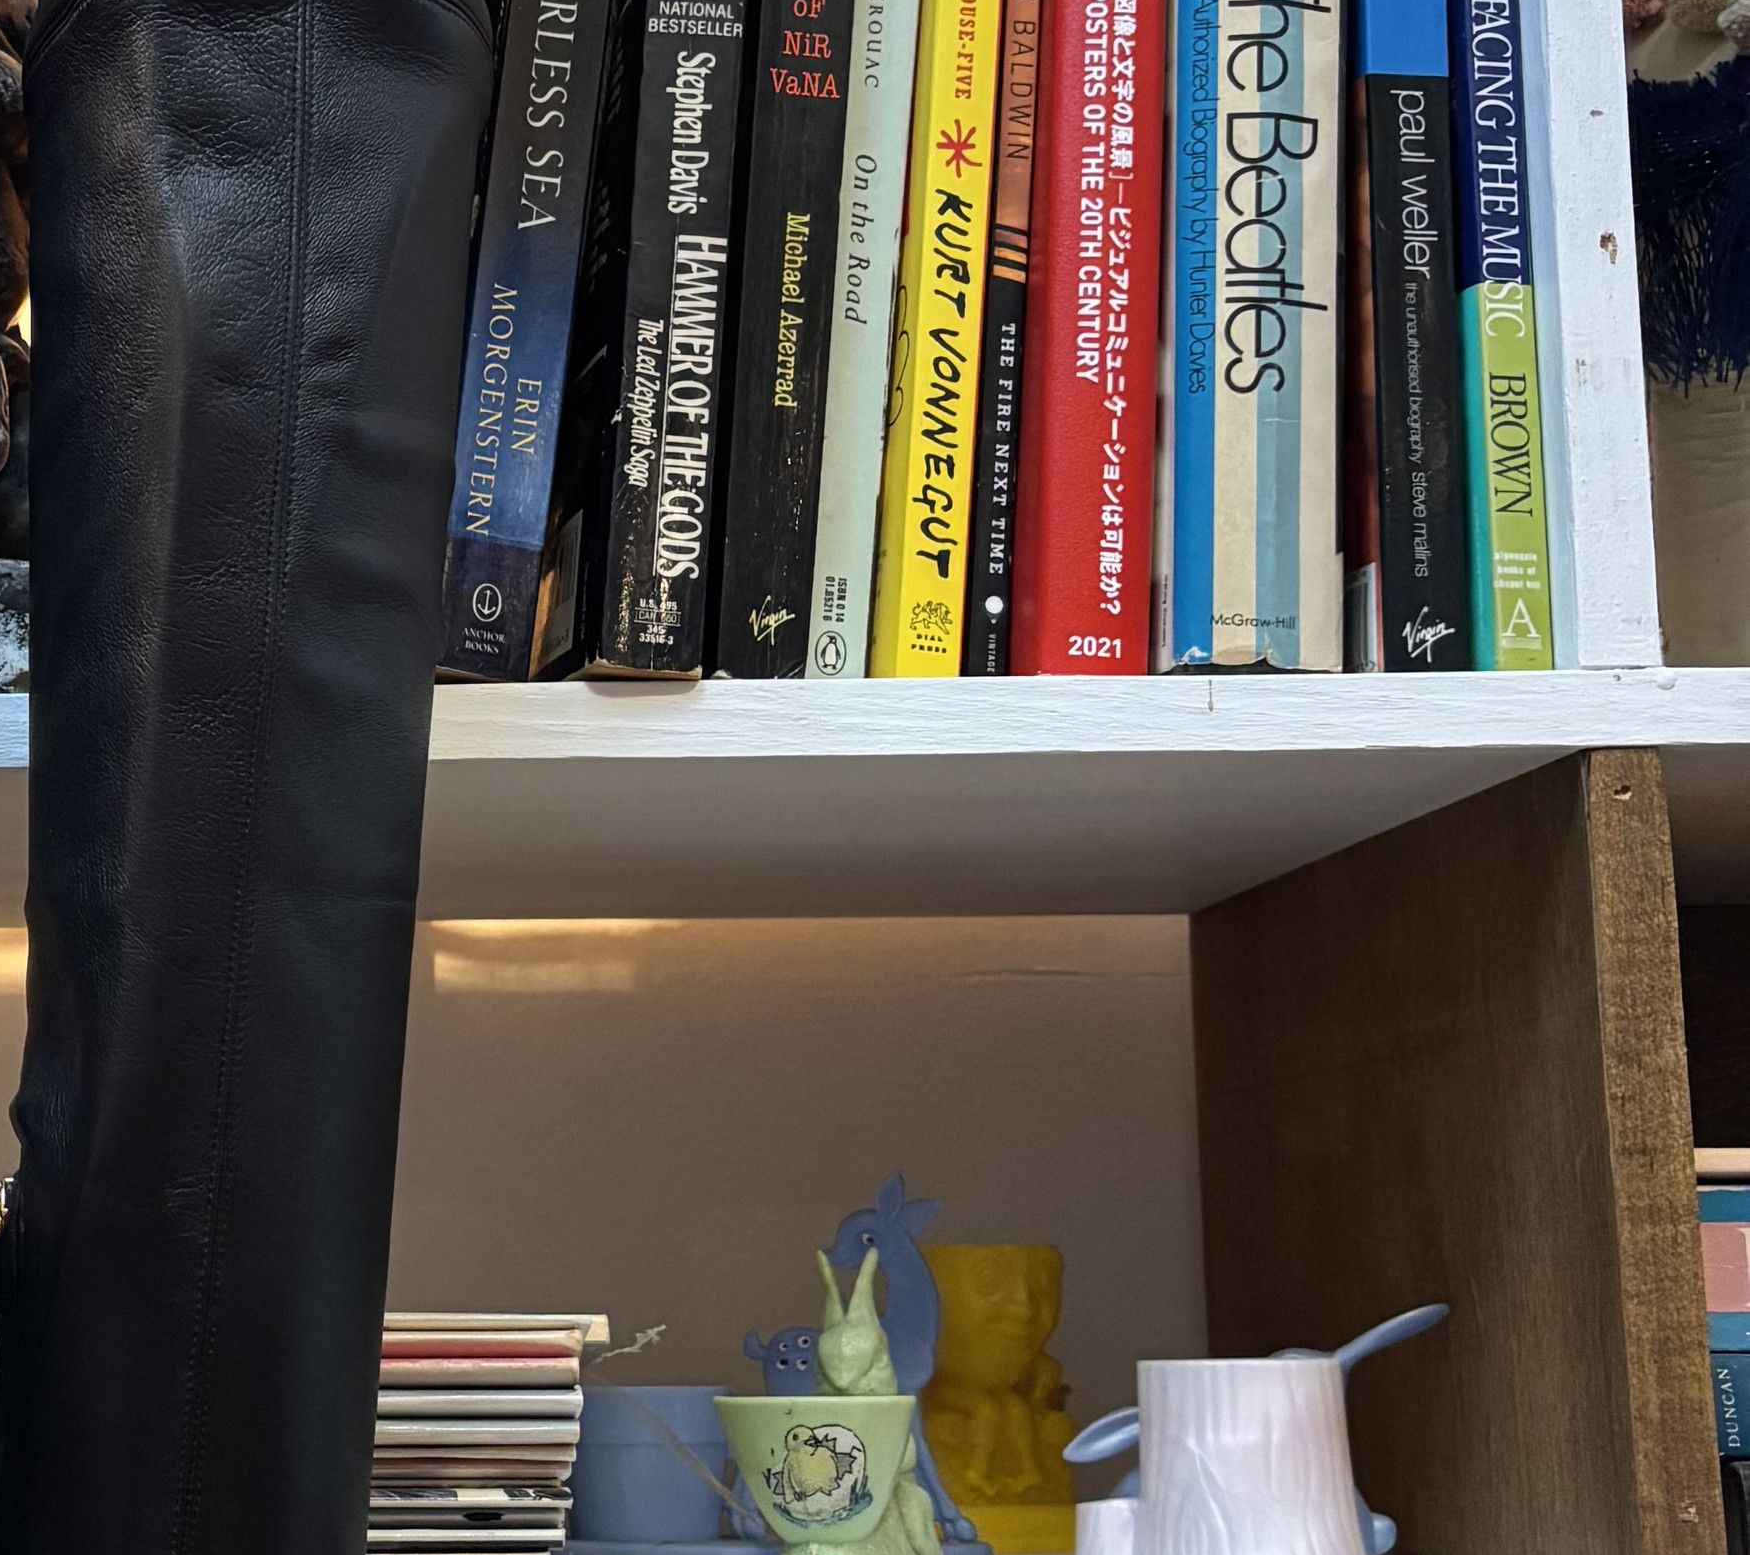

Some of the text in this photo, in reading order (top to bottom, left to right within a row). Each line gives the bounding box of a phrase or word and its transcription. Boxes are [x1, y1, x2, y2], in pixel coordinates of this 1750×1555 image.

[648, 18, 744, 39] BESTSELLER
[659, 0, 735, 20] NATIONAL
[666, 50, 717, 216] Stephen Davis
[1006, 20, 1036, 161] BALDWIN
[1081, 104, 1106, 135] OF
[517, 145, 565, 231] SEA
[1080, 142, 1105, 192] THE
[1184, 106, 1221, 213] Biography
[1390, 89, 1440, 280] paul weller
[1477, 137, 1521, 217] THE
[845, 154, 878, 325] On the Road
[1079, 197, 1104, 259] 20TH
[1182, 216, 1219, 246] by
[1224, 111, 1329, 396] Beatles
[774, 211, 811, 409] Michael Azerrad
[1075, 264, 1102, 384] CENTURY
[1189, 251, 1217, 317] Hunter
[1481, 222, 1526, 338] MUSIC
[912, 188, 974, 579] KURT VONNEGUT
[1188, 320, 1215, 394] Davies
[465, 282, 519, 537] MORGENSTERN
[510, 377, 543, 455] ERIN
[657, 234, 728, 581] HAMMER OF THE GODS
[988, 322, 1017, 575] THE FIRE NEXT TIME
[1488, 371, 1533, 518] BROWN
[1411, 472, 1431, 578] steve malins
[464, 641, 501, 655] BOOKS
[986, 633, 996, 674] VINTAGE
[1068, 636, 1122, 658] 2021
[1210, 613, 1296, 630] McGraw-Hill
